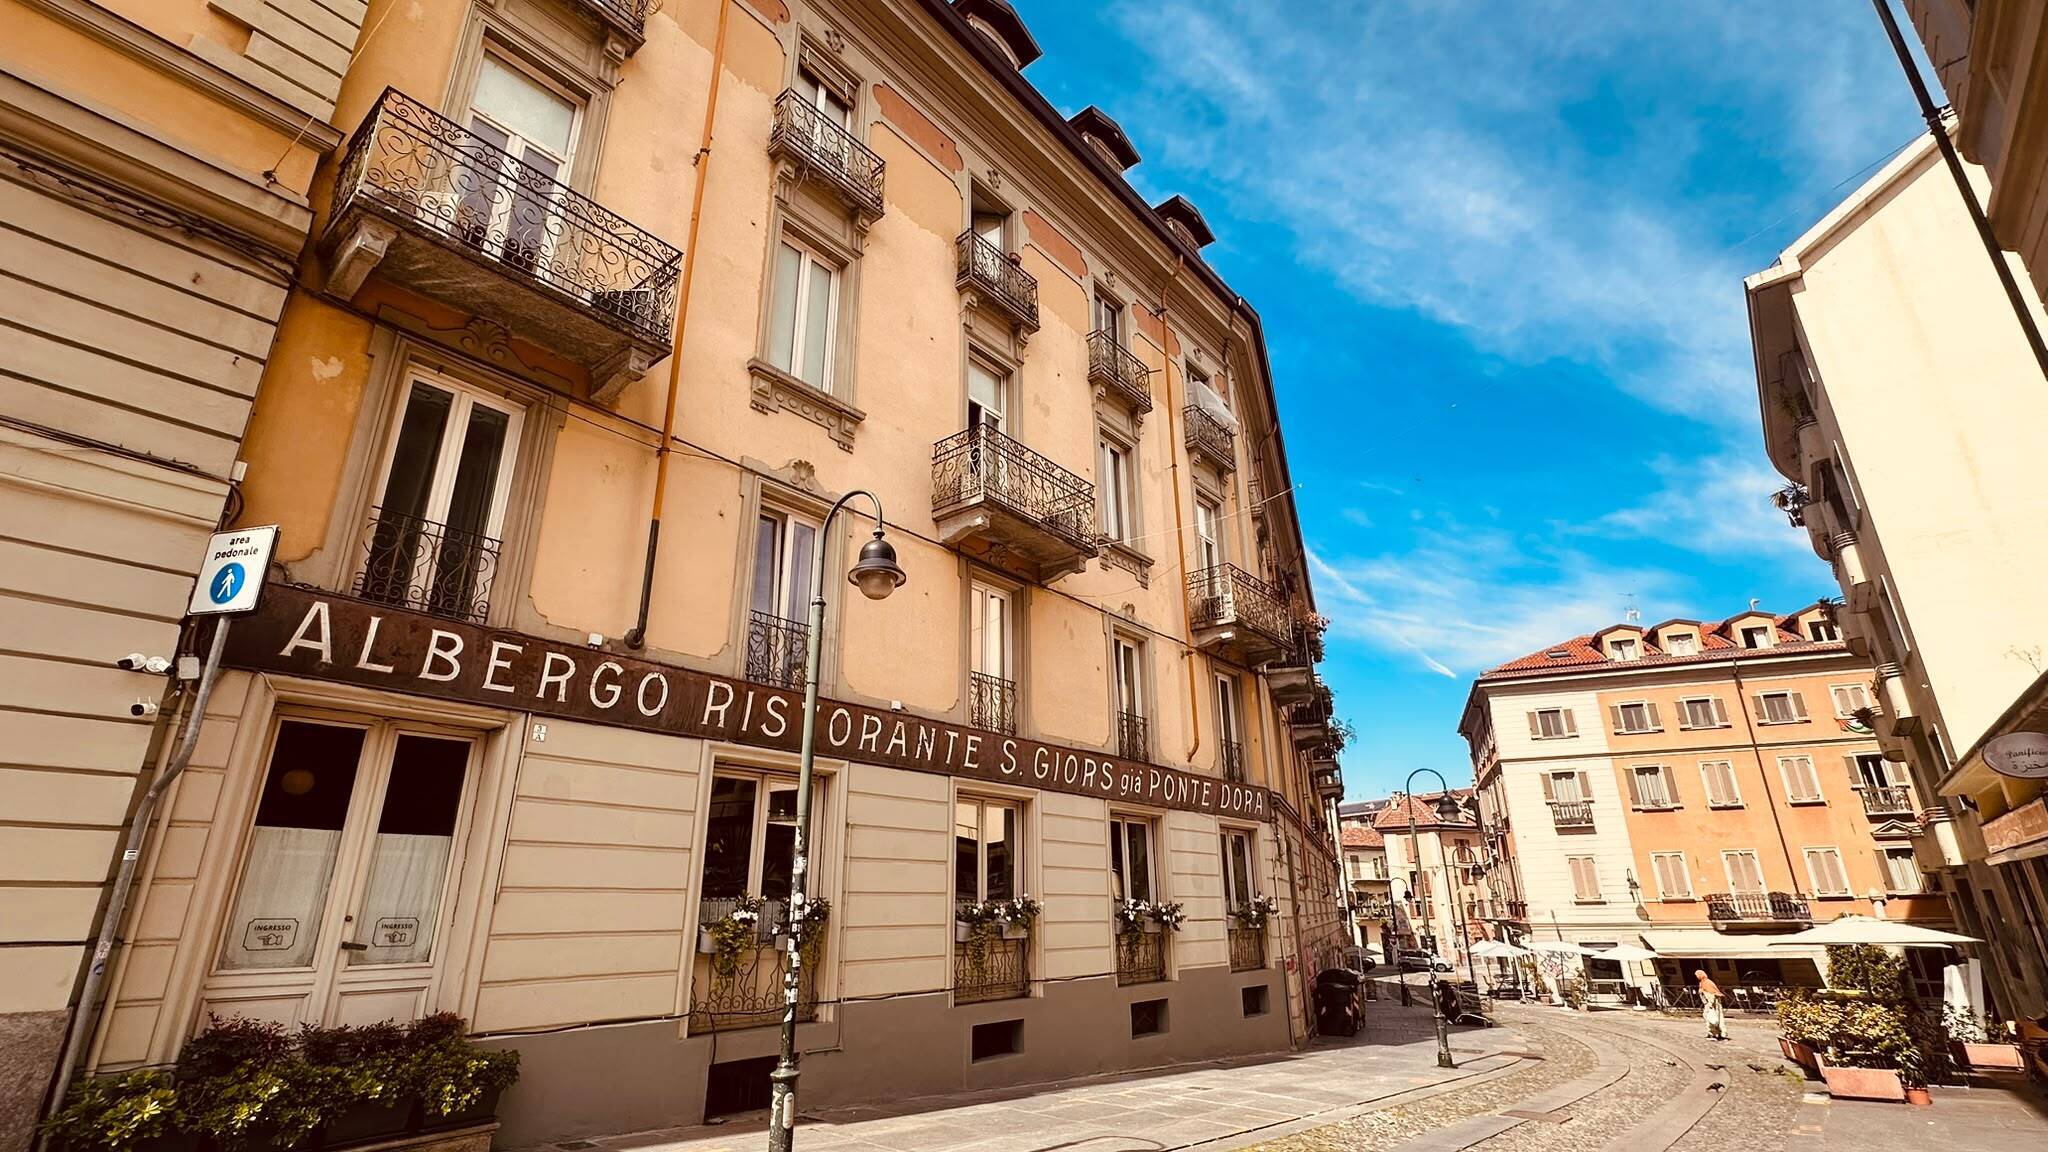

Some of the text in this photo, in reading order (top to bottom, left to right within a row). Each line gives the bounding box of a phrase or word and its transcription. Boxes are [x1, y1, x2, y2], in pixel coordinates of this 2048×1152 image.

[229, 536, 251, 546] area
[214, 546, 259, 561] pedonale
[278, 601, 1263, 815] ALBERGO RISORANTE S. GIORS già PONTE DORA
